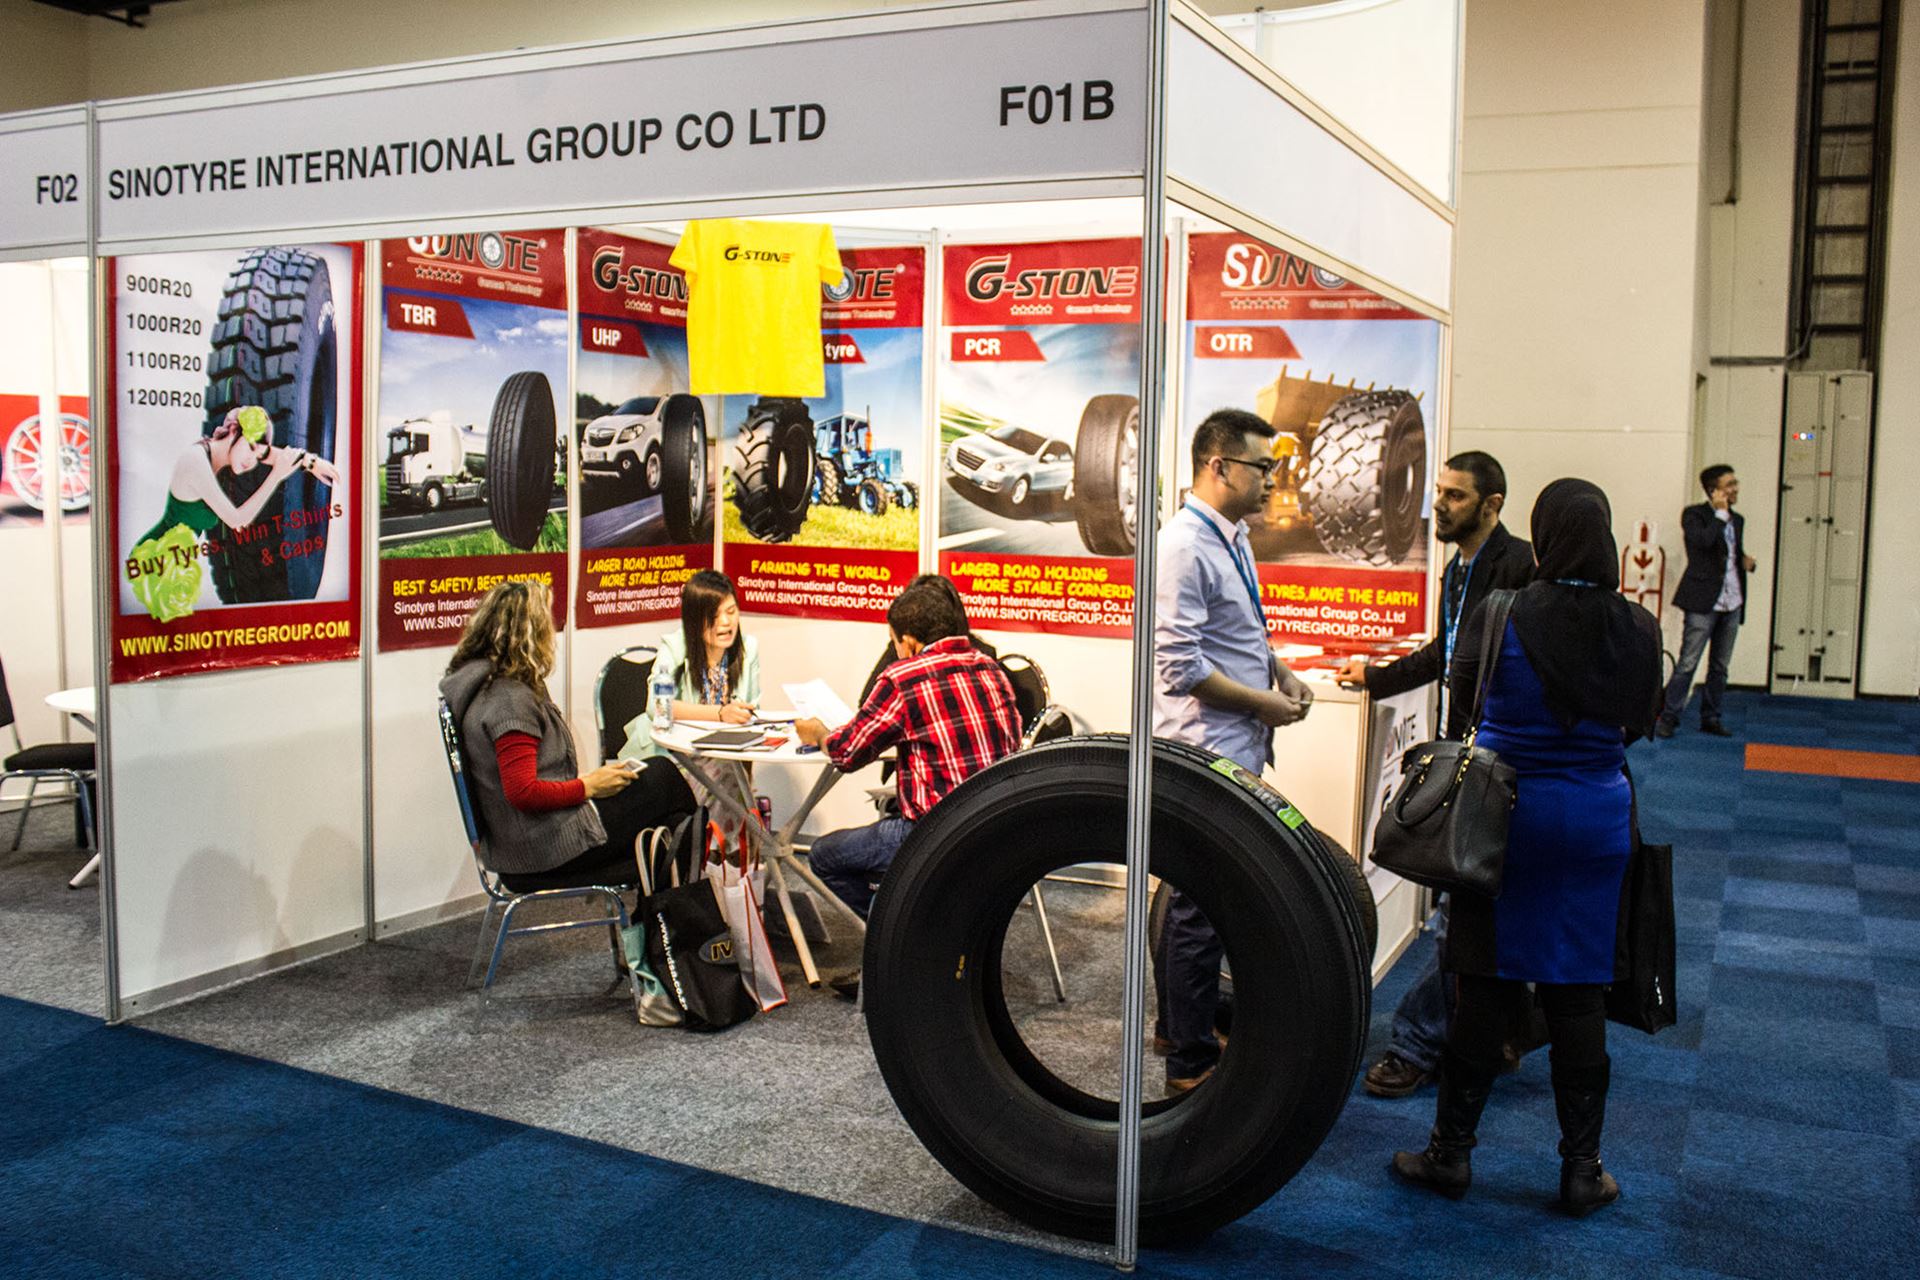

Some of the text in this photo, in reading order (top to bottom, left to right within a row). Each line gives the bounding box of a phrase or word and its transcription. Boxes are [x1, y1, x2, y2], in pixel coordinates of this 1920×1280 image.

[999, 79, 1115, 126] F01B
[108, 103, 826, 201] SINOTYRE INTERNATIONAL GROUP CO LTD
[36, 174, 78, 204] F02
[126, 274, 192, 298] 900R20
[965, 253, 1139, 302] G-STONE
[126, 312, 202, 336] 1000R20
[400, 302, 437, 326] TBR
[592, 327, 622, 347] UHP
[965, 338, 1001, 356] PCR
[1210, 333, 1253, 352] OTR
[126, 350, 202, 373] 1100R20
[825, 343, 856, 360] tyre
[127, 388, 202, 409] 1200R20
[125, 555, 165, 580] Buy
[232, 523, 269, 546] Win
[271, 503, 343, 536] T-Shirts
[260, 534, 325, 566] & Caps
[586, 555, 686, 574] LARGER ROAD HOLDING
[751, 559, 891, 581] FARMING THE WORLD
[950, 561, 1108, 582] LARGER ROAD HOLDING
[393, 578, 426, 597] BEST
[599, 572, 626, 588] MORE
[628, 571, 660, 586] STABLE
[737, 576, 776, 591] Sinotyre
[777, 578, 835, 593] International
[837, 582, 867, 596] Group
[972, 578, 1009, 593] MORE
[1013, 580, 1064, 596] STABLE
[393, 600, 436, 616] Sinotyre
[1000, 594, 1065, 610] International
[1067, 599, 1101, 613] Group
[1347, 588, 1373, 605] THE
[1376, 589, 1419, 607] EARTH
[1320, 606, 1358, 622] Group
[120, 620, 350, 657] WWW.SINOTYREGROUP.COM
